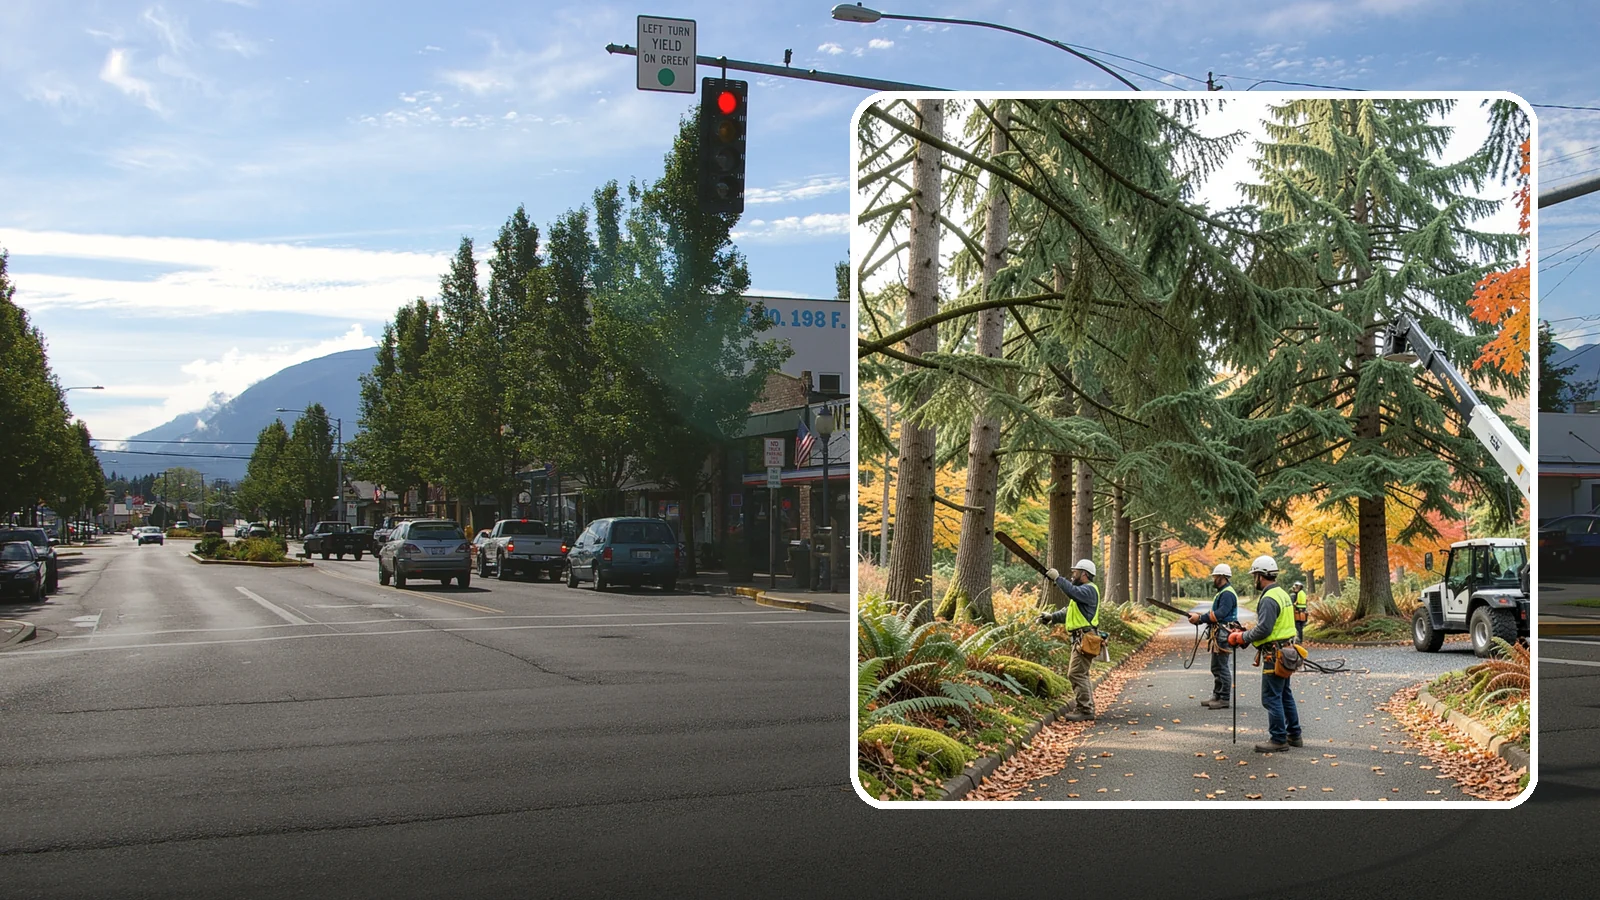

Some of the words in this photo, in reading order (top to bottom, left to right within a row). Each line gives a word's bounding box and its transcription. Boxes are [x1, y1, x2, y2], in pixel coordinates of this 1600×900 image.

[643, 24, 663, 34] LEFT
[668, 26, 690, 36] TURN
[652, 38, 682, 51] YIELD
[644, 54, 656, 63] ON
[661, 55, 689, 66] GREEN
[791, 309, 826, 328] 198
[831, 311, 847, 329] F.
